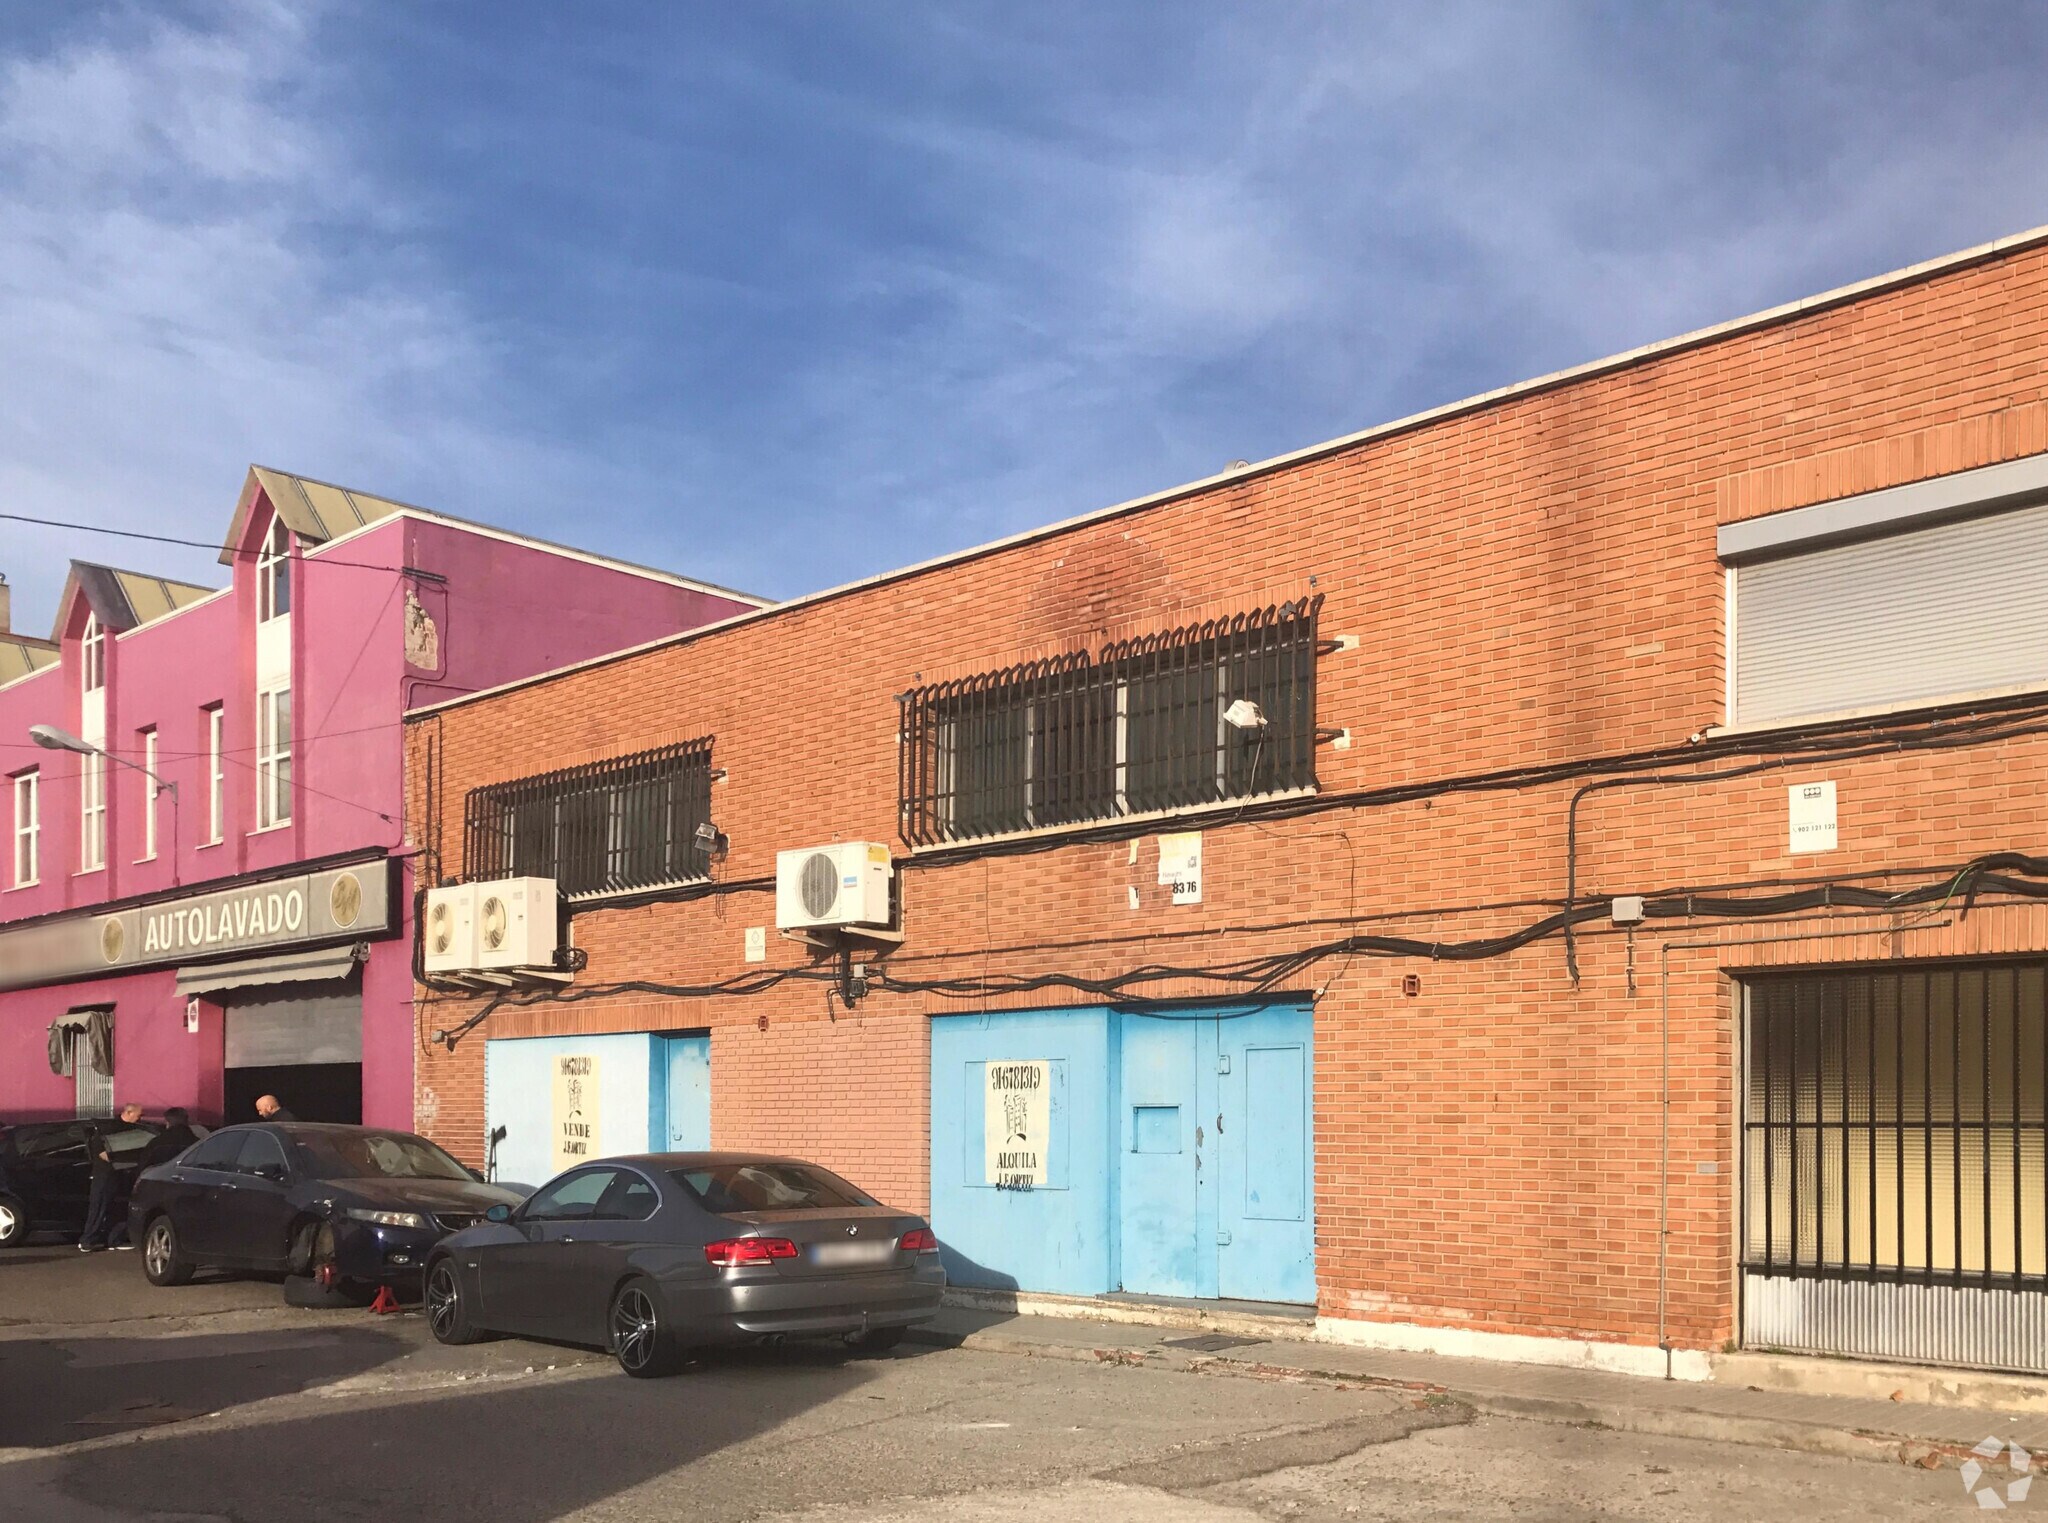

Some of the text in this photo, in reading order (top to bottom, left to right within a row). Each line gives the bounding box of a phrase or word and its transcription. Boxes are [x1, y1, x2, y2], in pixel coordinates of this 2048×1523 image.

[1172, 881, 1197, 894] 83 76
[144, 889, 303, 953] AUTOLAVADO
[563, 1122, 591, 1138] VENDE
[996, 1152, 1037, 1169] ALQUILA
